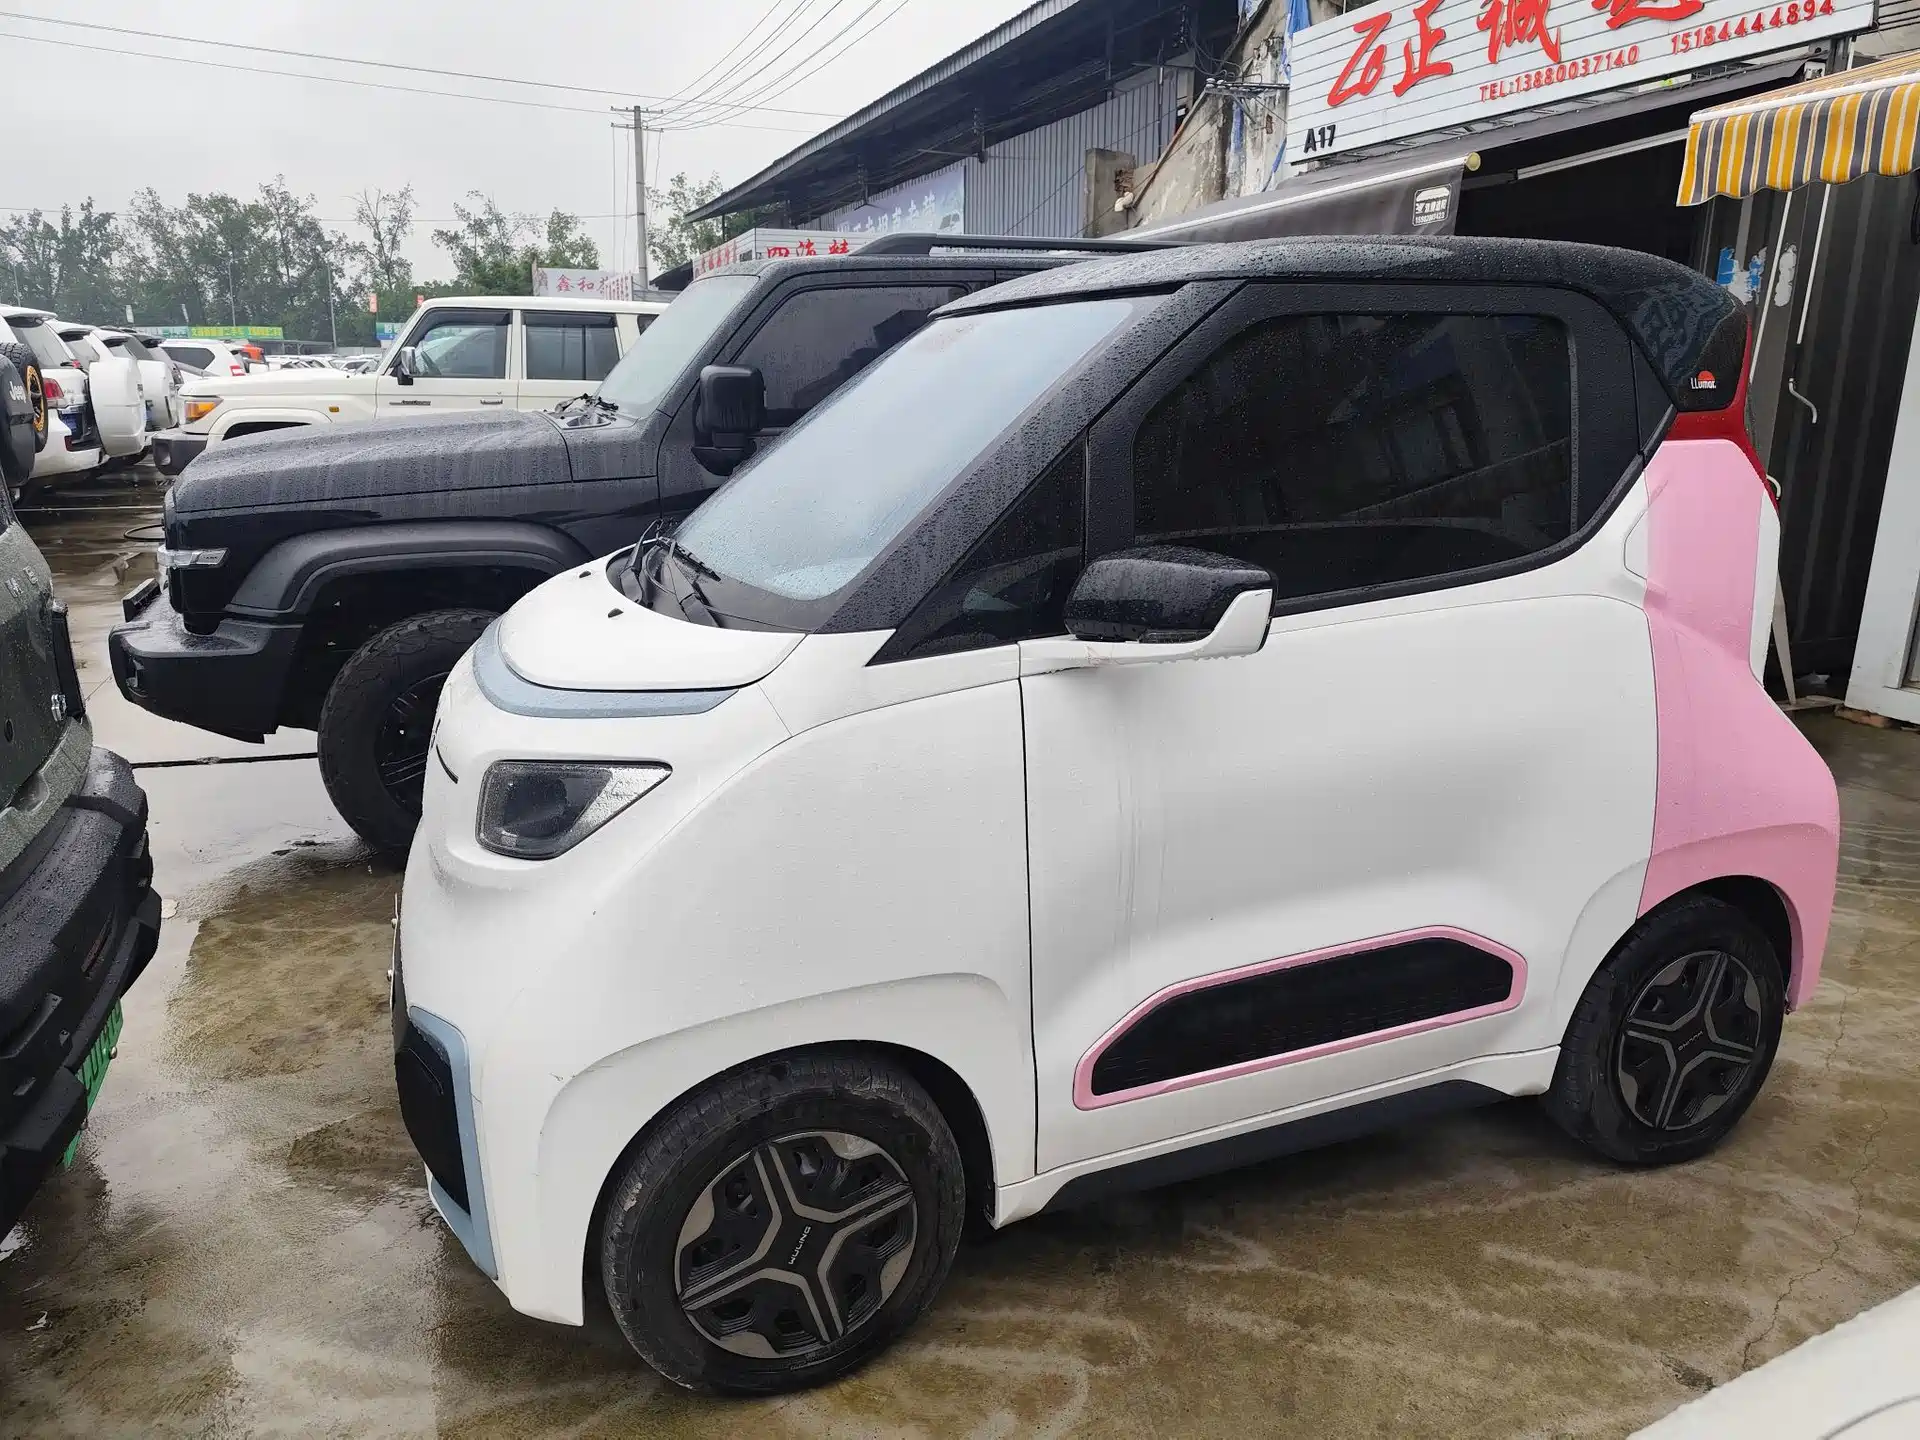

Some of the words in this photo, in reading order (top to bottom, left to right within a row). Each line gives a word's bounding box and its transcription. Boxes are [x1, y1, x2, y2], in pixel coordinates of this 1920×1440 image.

[1479, 45, 1640, 102] TEL:13880037140
[1671, 0, 1835, 55] 15184444894
[1303, 124, 1336, 153] A17
[787, 1225, 812, 1265] WULING
